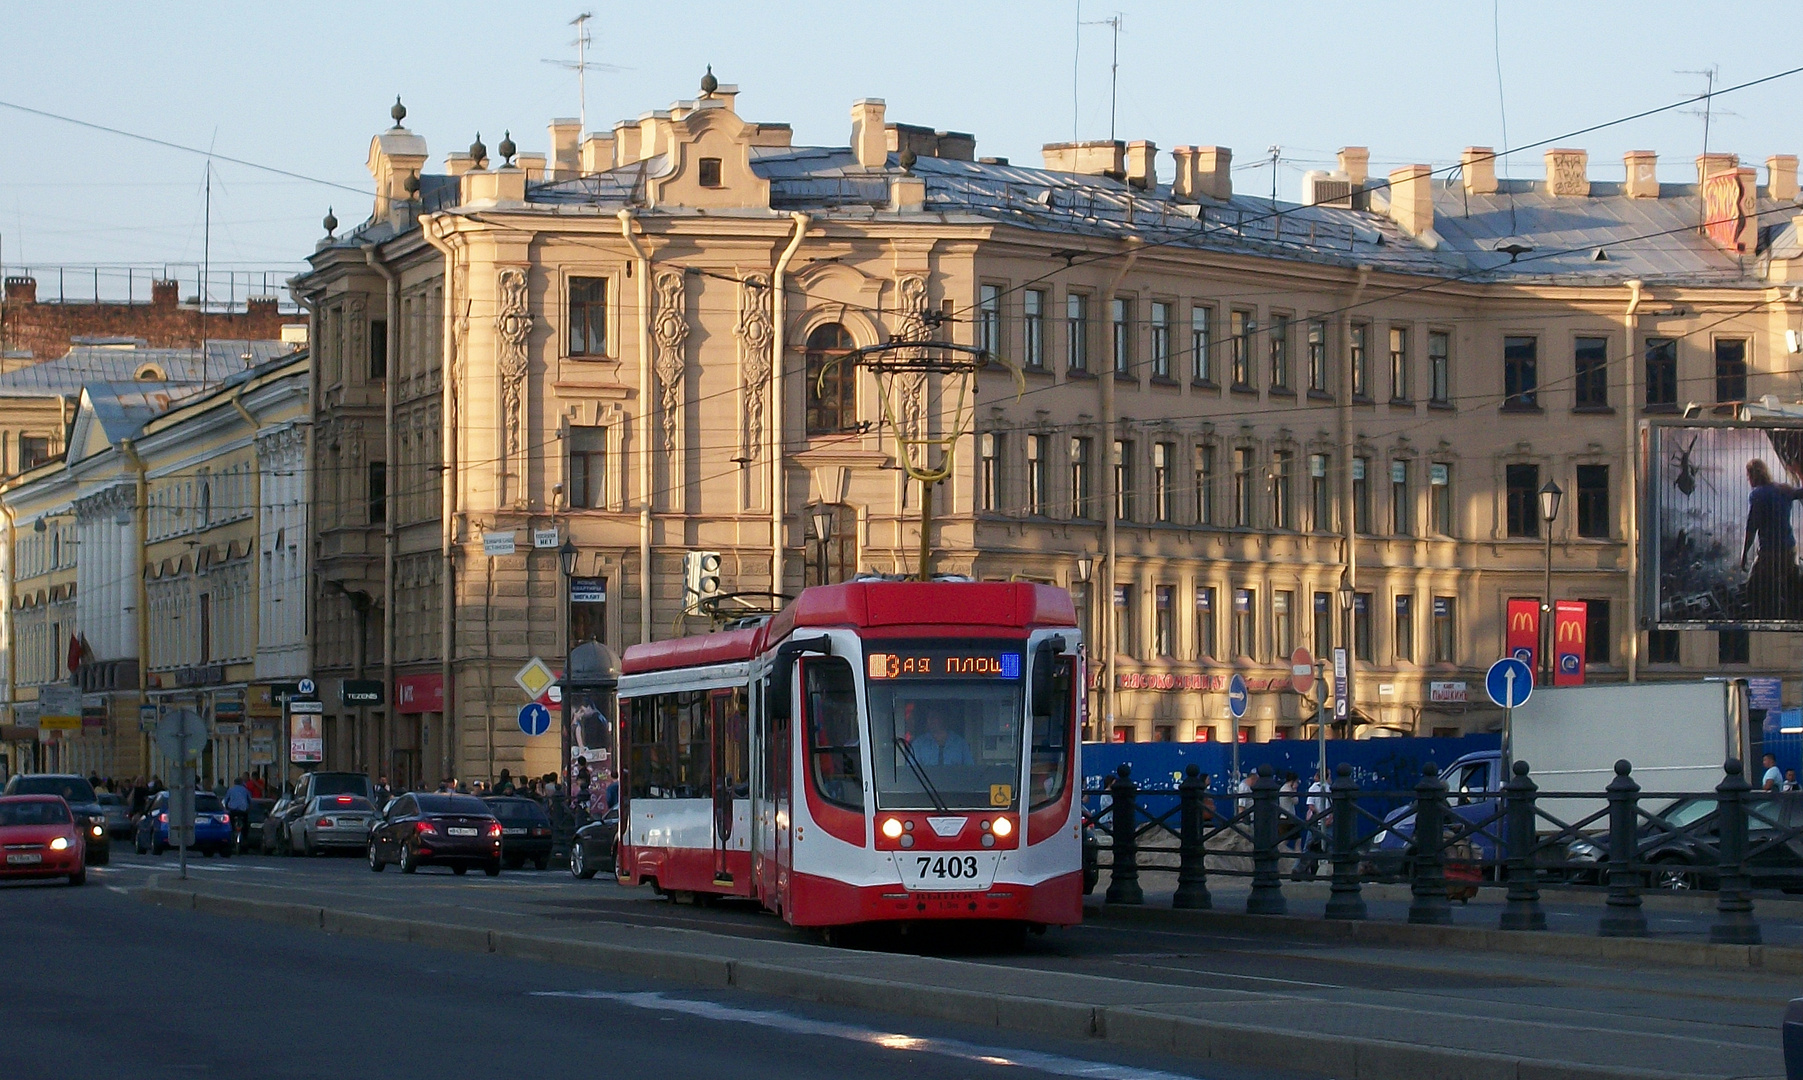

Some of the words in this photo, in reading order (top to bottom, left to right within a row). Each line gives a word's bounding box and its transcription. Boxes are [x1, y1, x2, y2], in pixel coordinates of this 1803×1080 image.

[903, 657, 931, 672] АЯ
[1120, 673, 1228, 690] МЯСОКОМБИНАТ
[916, 856, 978, 879] 7403
